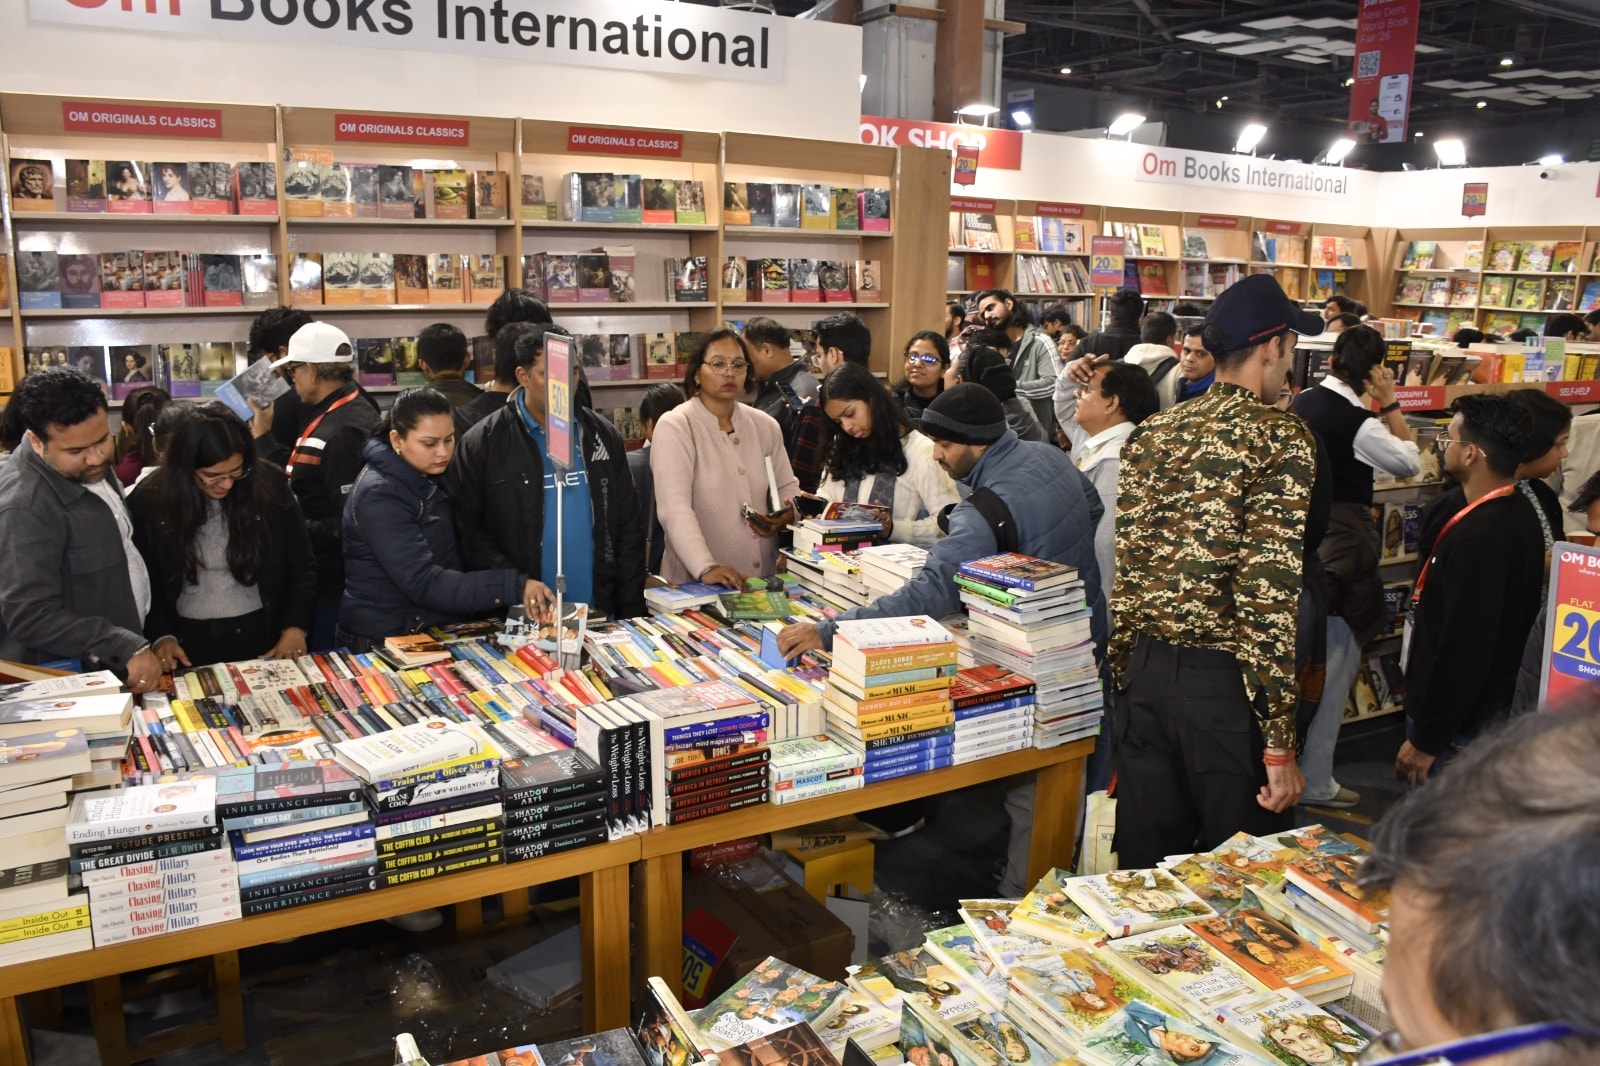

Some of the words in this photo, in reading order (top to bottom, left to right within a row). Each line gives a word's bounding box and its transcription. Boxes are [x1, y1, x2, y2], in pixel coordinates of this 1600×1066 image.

[1362, 22, 1385, 32] World
[1387, 17, 1409, 28] Book
[436, 0, 770, 69] International
[1361, 34, 1377, 43] Fair
[68, 110, 90, 123] OM
[91, 111, 157, 127] ORIGINALS
[158, 115, 217, 130] CLASSICS
[339, 121, 358, 133] OM
[360, 122, 413, 136] ORIGINALS
[414, 125, 465, 139] CLASSICS
[571, 133, 588, 144] OM
[589, 134, 635, 147] ORIGINALS
[636, 137, 679, 150] CLASSICS
[859, 123, 899, 146] OK
[908, 128, 986, 158] SHOP
[1142, 151, 1177, 177] Om
[1183, 155, 1241, 184] Books
[1245, 161, 1348, 195] International
[1095, 257, 1110, 270] 20
[552, 384, 562, 413] 50
[1560, 387, 1591, 396] SELF-HELP
[1561, 551, 1585, 566] OM
[1570, 597, 1594, 609] FLAT
[860, 702, 887, 710] NOBODY
[672, 732, 692, 741] THINGS
[872, 738, 888, 748] SHE
[888, 735, 905, 744] TOO
[608, 743, 619, 773] Weight
[621, 740, 632, 769] Weight
[712, 745, 731, 758] BONES
[673, 757, 684, 765] JOE
[392, 774, 415, 787] Train
[416, 772, 436, 783] Lord
[443, 766, 467, 779] Oliver
[470, 761, 485, 772] Mol
[796, 774, 822, 784] MASCOT
[513, 787, 549, 800] SHADOW
[553, 785, 572, 794] Damien
[572, 782, 585, 790] Love
[611, 779, 620, 799] Loss
[624, 775, 633, 795] Loss
[387, 793, 409, 803] DIANE
[389, 801, 409, 809] COOK
[521, 795, 542, 805] ARTS
[404, 809, 437, 818] ROOFTOP
[515, 805, 550, 819] SHADOW
[554, 803, 573, 812] Damien
[573, 800, 586, 808] Love
[522, 813, 543, 823] ARTS
[253, 816, 264, 826] ON
[264, 815, 278, 824] THIS
[279, 813, 291, 822] DAY
[390, 817, 433, 836] HELL-BENT
[72, 829, 106, 840] Ending
[107, 824, 141, 836] Hunger
[115, 837, 154, 849] FUTURE
[157, 829, 208, 843] PRESENCE
[284, 840, 298, 848] EYES
[334, 830, 353, 838] WORLD
[383, 843, 394, 852] THE
[395, 838, 415, 850] COFFIN
[416, 835, 431, 845] CLUB
[712, 847, 735, 857] BOOK
[80, 861, 96, 871] THE
[98, 856, 123, 868] GREAT
[126, 850, 155, 864] DIVIDE
[182, 842, 205, 853] OWEN
[270, 853, 291, 862] Bodies
[292, 849, 308, 858] Their
[308, 844, 339, 855] Battlefield
[385, 860, 397, 869] THE
[397, 855, 417, 867] COFFIN
[418, 852, 433, 862] CLUB
[120, 864, 154, 877] Chasing
[160, 858, 190, 871] Hillary
[127, 877, 161, 892] Chasing
[167, 872, 197, 885] Hillary
[249, 876, 330, 898] INHERITANCE
[250, 891, 331, 912] INHERITANCE
[22, 914, 49, 925] Inside
[52, 911, 68, 919] Out
[130, 908, 163, 922] Chasing
[169, 901, 199, 915] Hillary
[24, 926, 50, 936] Inside
[53, 922, 69, 931] Out
[131, 922, 165, 937] Chasing
[170, 915, 200, 929] Hillary
[1286, 963, 1305, 973] LAST
[1306, 960, 1321, 969] THE
[1181, 978, 1218, 992] WILLOWS
[1218, 974, 1238, 982] THE
[1227, 979, 1244, 988] THE
[1190, 990, 1202, 998] IN
[1202, 984, 1226, 995] WIND
[1238, 1012, 1266, 1026] SILAS
[1267, 1000, 1305, 1018] MARNER
[723, 1013, 765, 1036] ROBINSON
[821, 1014, 887, 1041] PERSUASION
